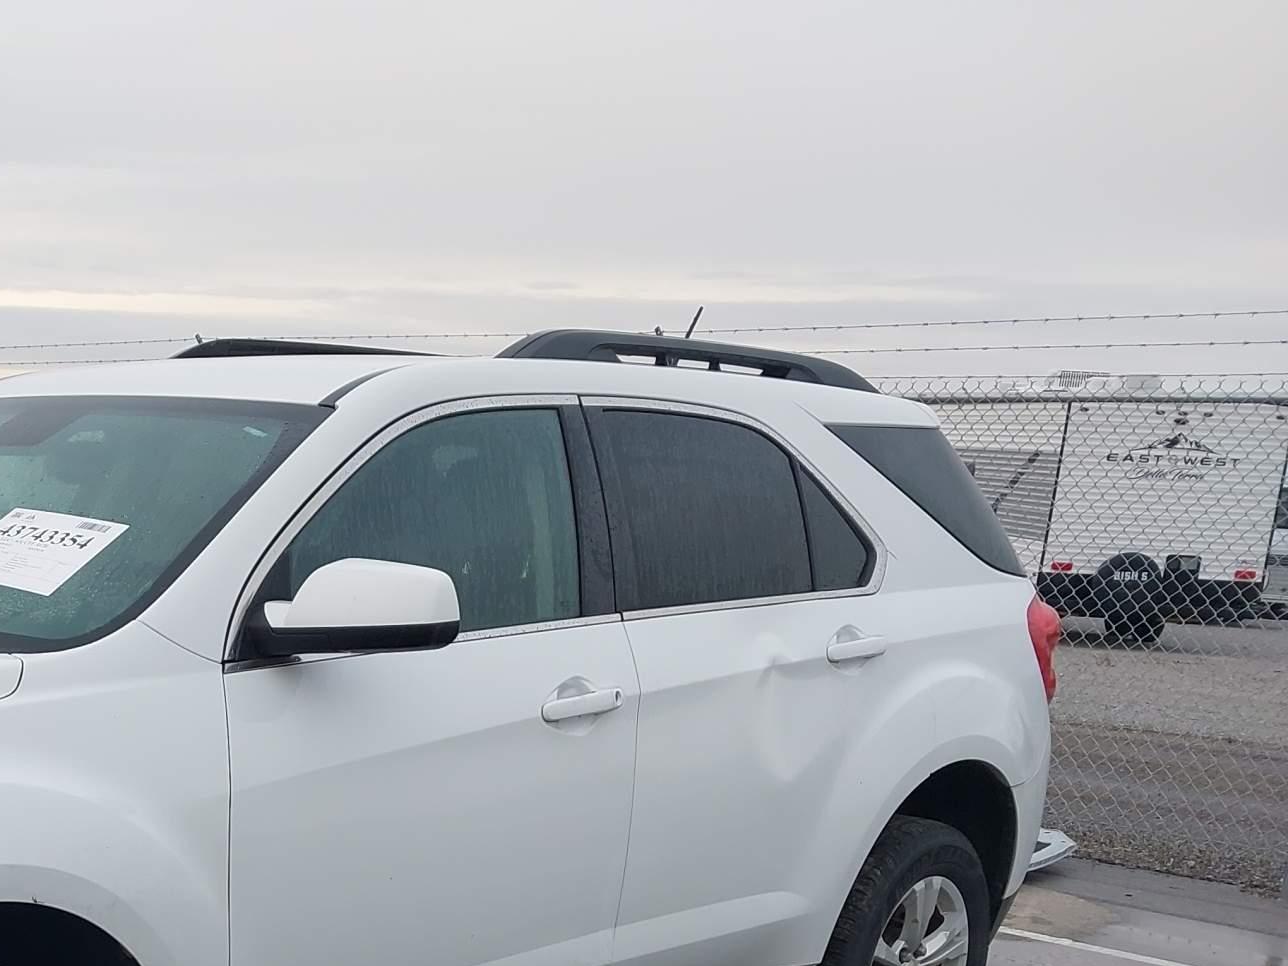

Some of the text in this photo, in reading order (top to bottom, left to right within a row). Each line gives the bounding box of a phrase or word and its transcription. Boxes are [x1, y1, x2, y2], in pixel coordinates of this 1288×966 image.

[1106, 453, 1163, 465] EAST
[1183, 455, 1241, 468] WEST
[0, 523, 95, 550] 43743354
